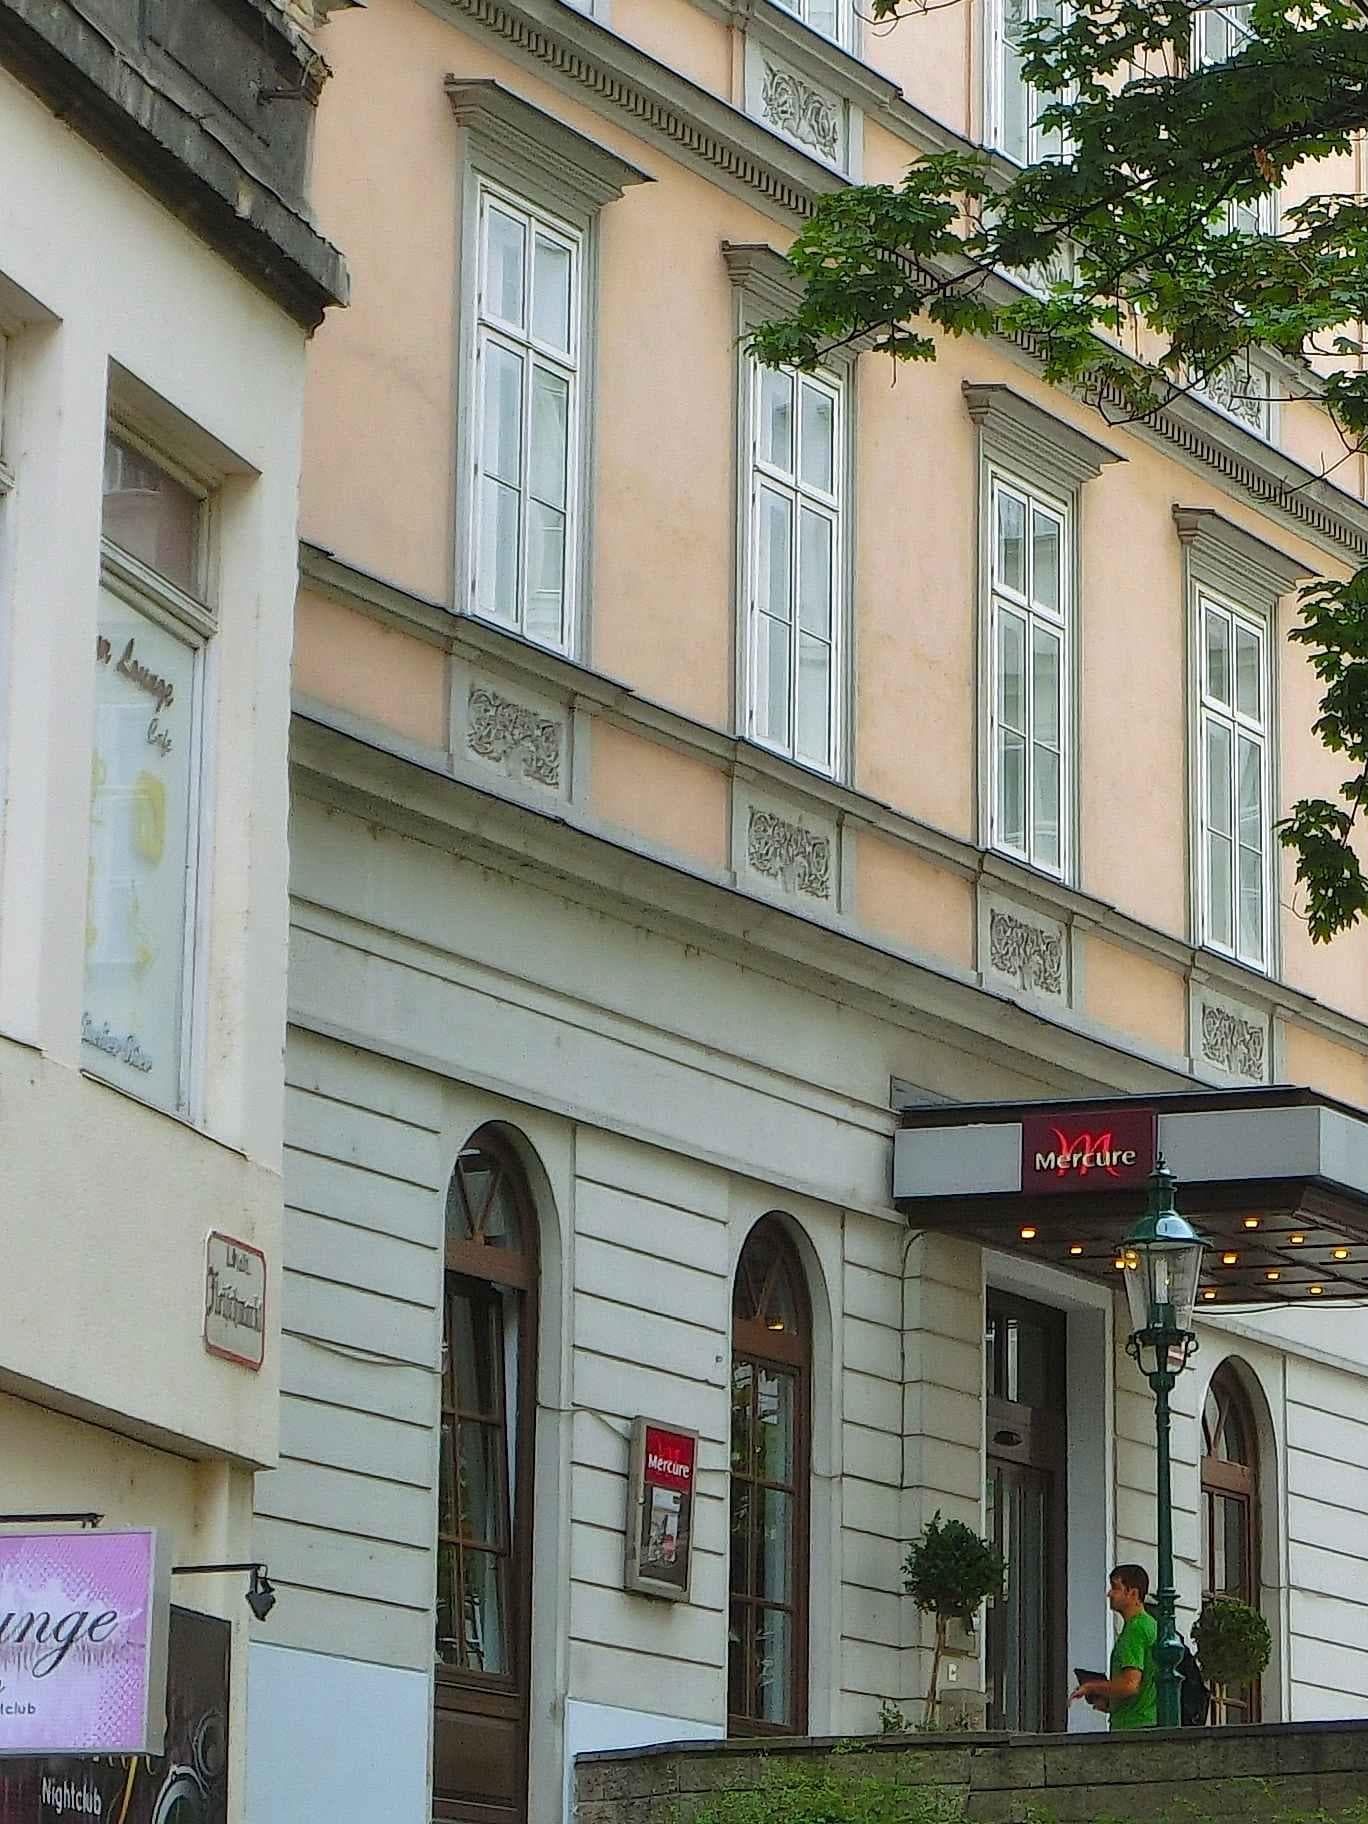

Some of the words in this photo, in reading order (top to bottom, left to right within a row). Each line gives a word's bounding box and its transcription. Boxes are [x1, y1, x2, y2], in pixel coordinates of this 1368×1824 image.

[1035, 1150, 1137, 1171] Mercure
[648, 1453, 690, 1479] Mercure
[42, 1776, 102, 1816] Nightclub
